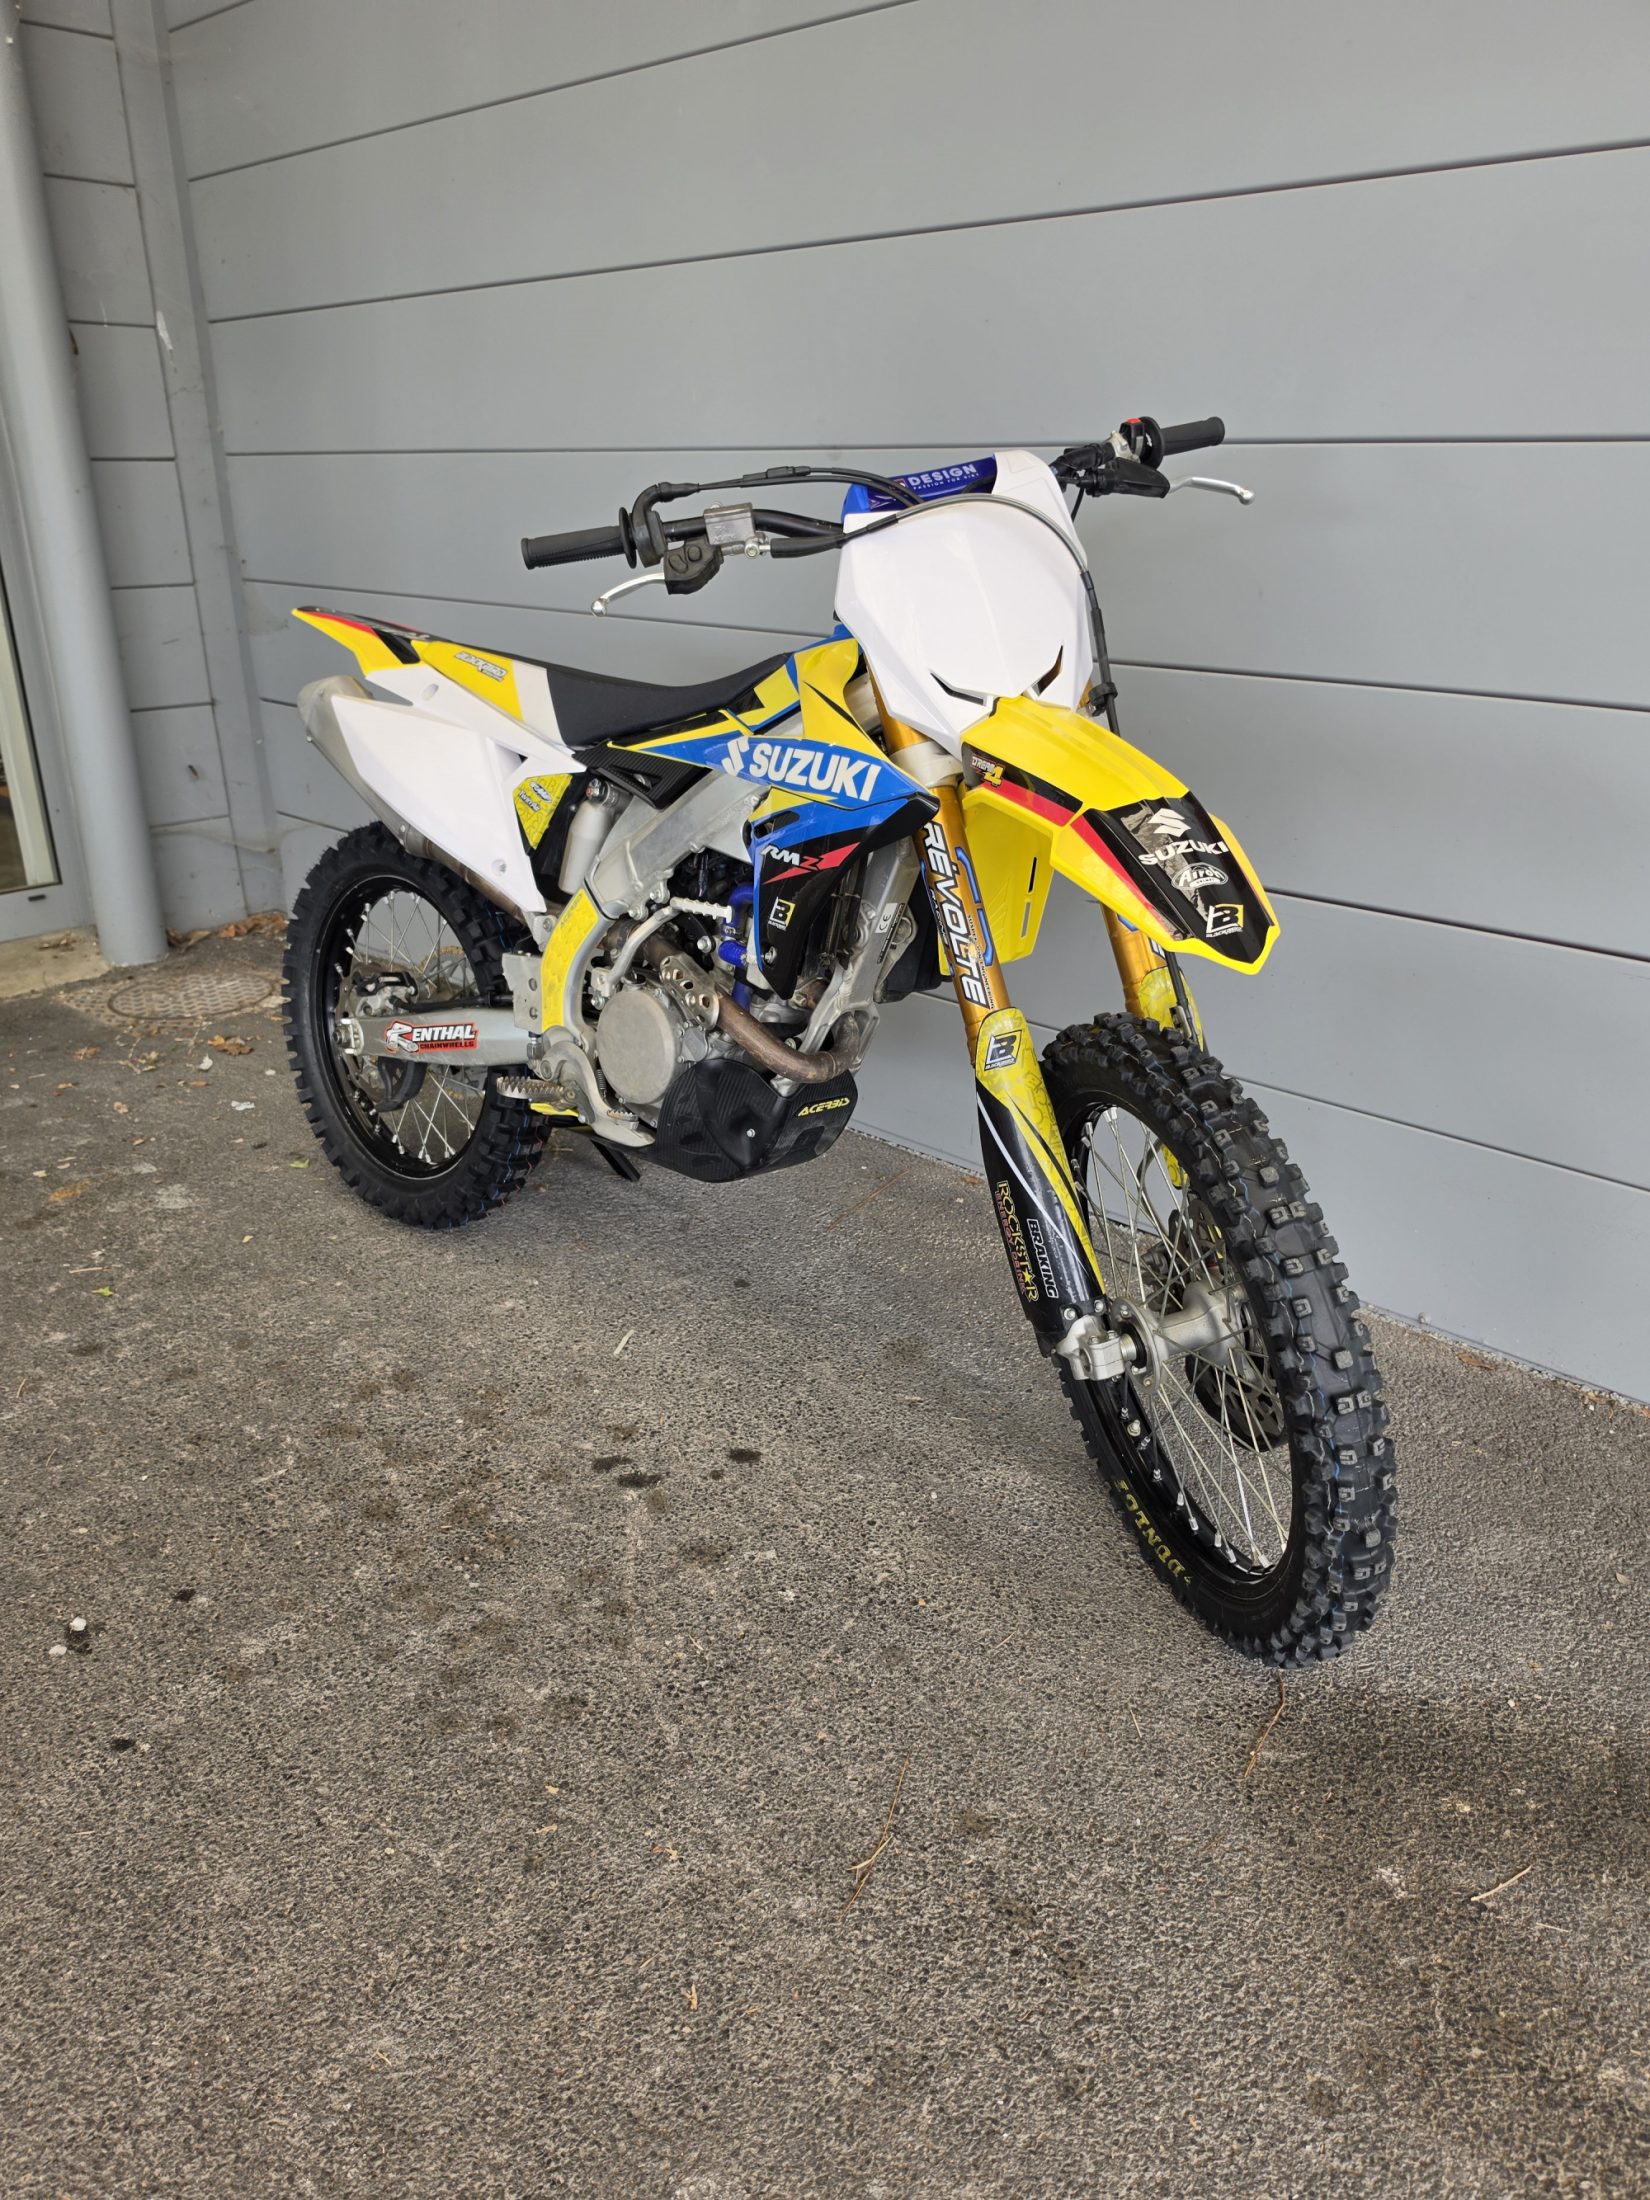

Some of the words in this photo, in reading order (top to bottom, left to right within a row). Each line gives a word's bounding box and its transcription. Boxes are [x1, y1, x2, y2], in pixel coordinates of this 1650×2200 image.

[907, 463, 978, 487] DESIGN
[749, 742, 882, 802] SUZUKI
[1138, 839, 1229, 865] SUZUKI
[386, 1021, 475, 1052] RENTHAL
[1026, 1218, 1059, 1299] BRAKING
